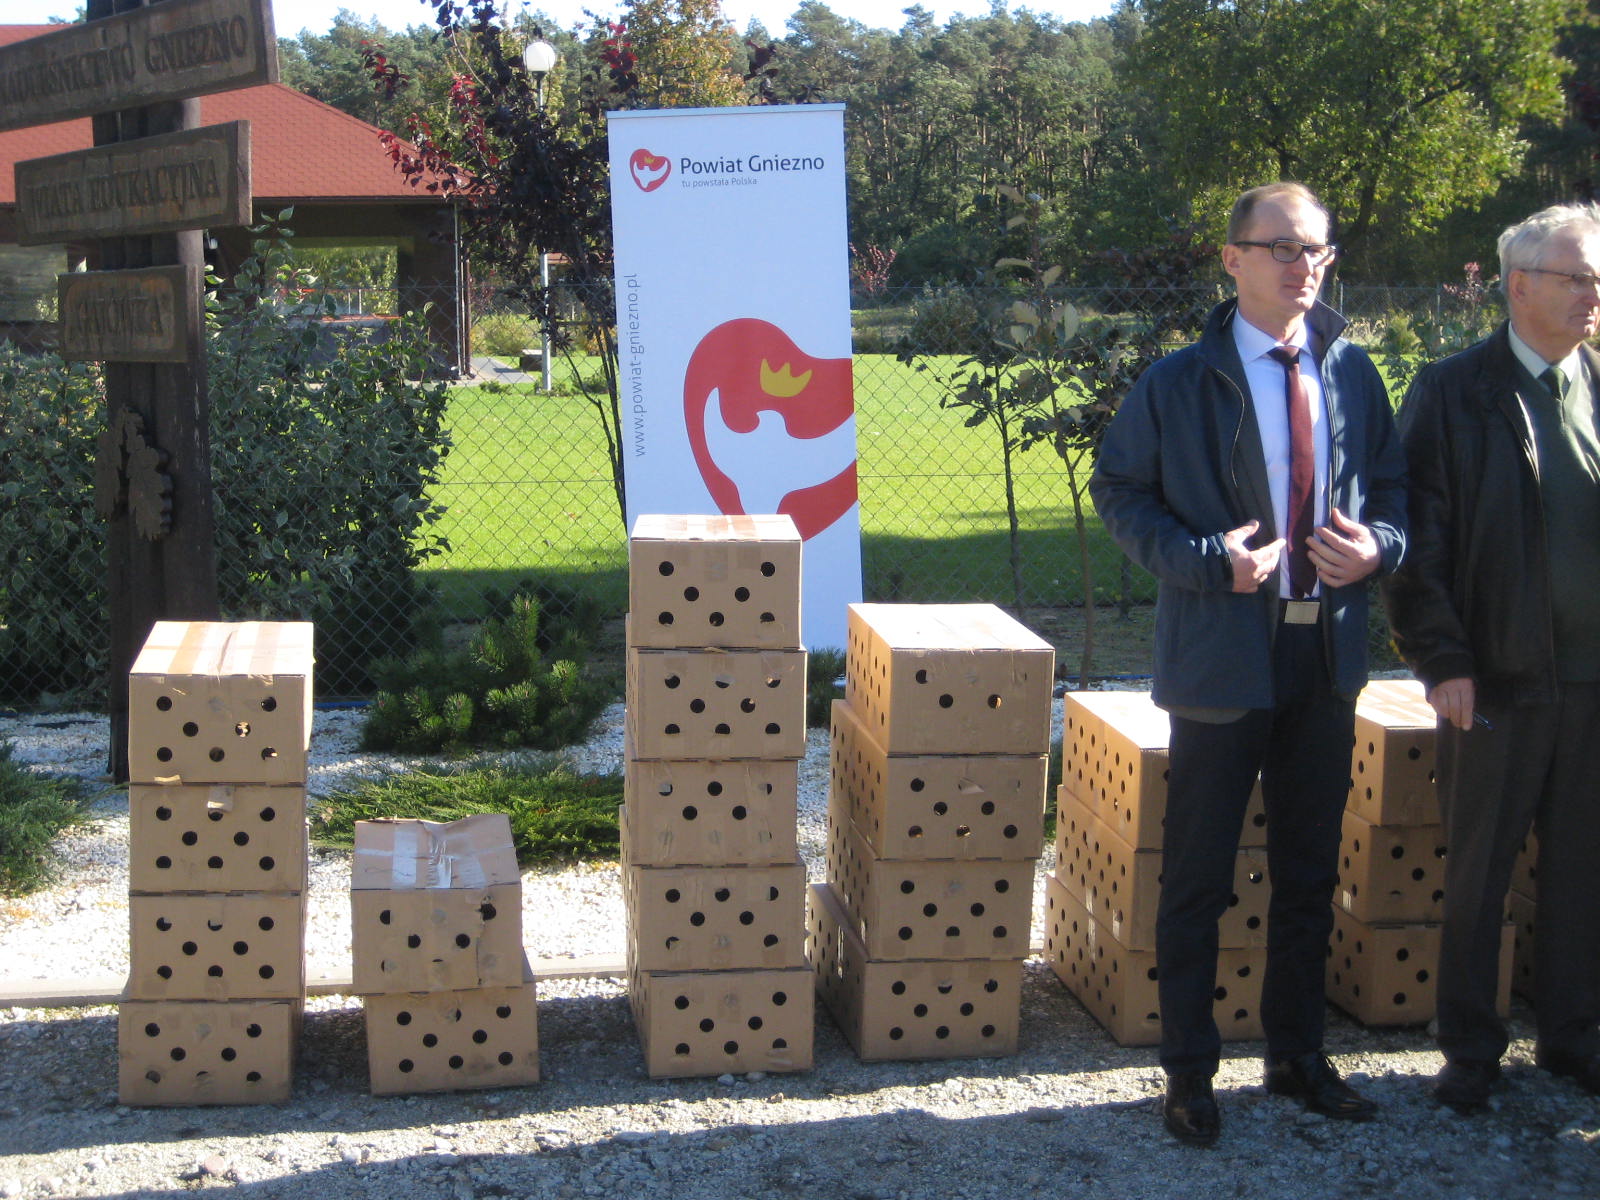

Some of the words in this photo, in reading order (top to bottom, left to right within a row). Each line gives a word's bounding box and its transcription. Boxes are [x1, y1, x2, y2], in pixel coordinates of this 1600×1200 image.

[145, 14, 248, 75] GNIEZNO
[680, 156, 743, 174] Powiat
[748, 154, 825, 172] Gniezno
[681, 179, 691, 188] tu
[731, 177, 757, 186] Polska
[624, 273, 648, 457] www.powiat-gniezno.pl
